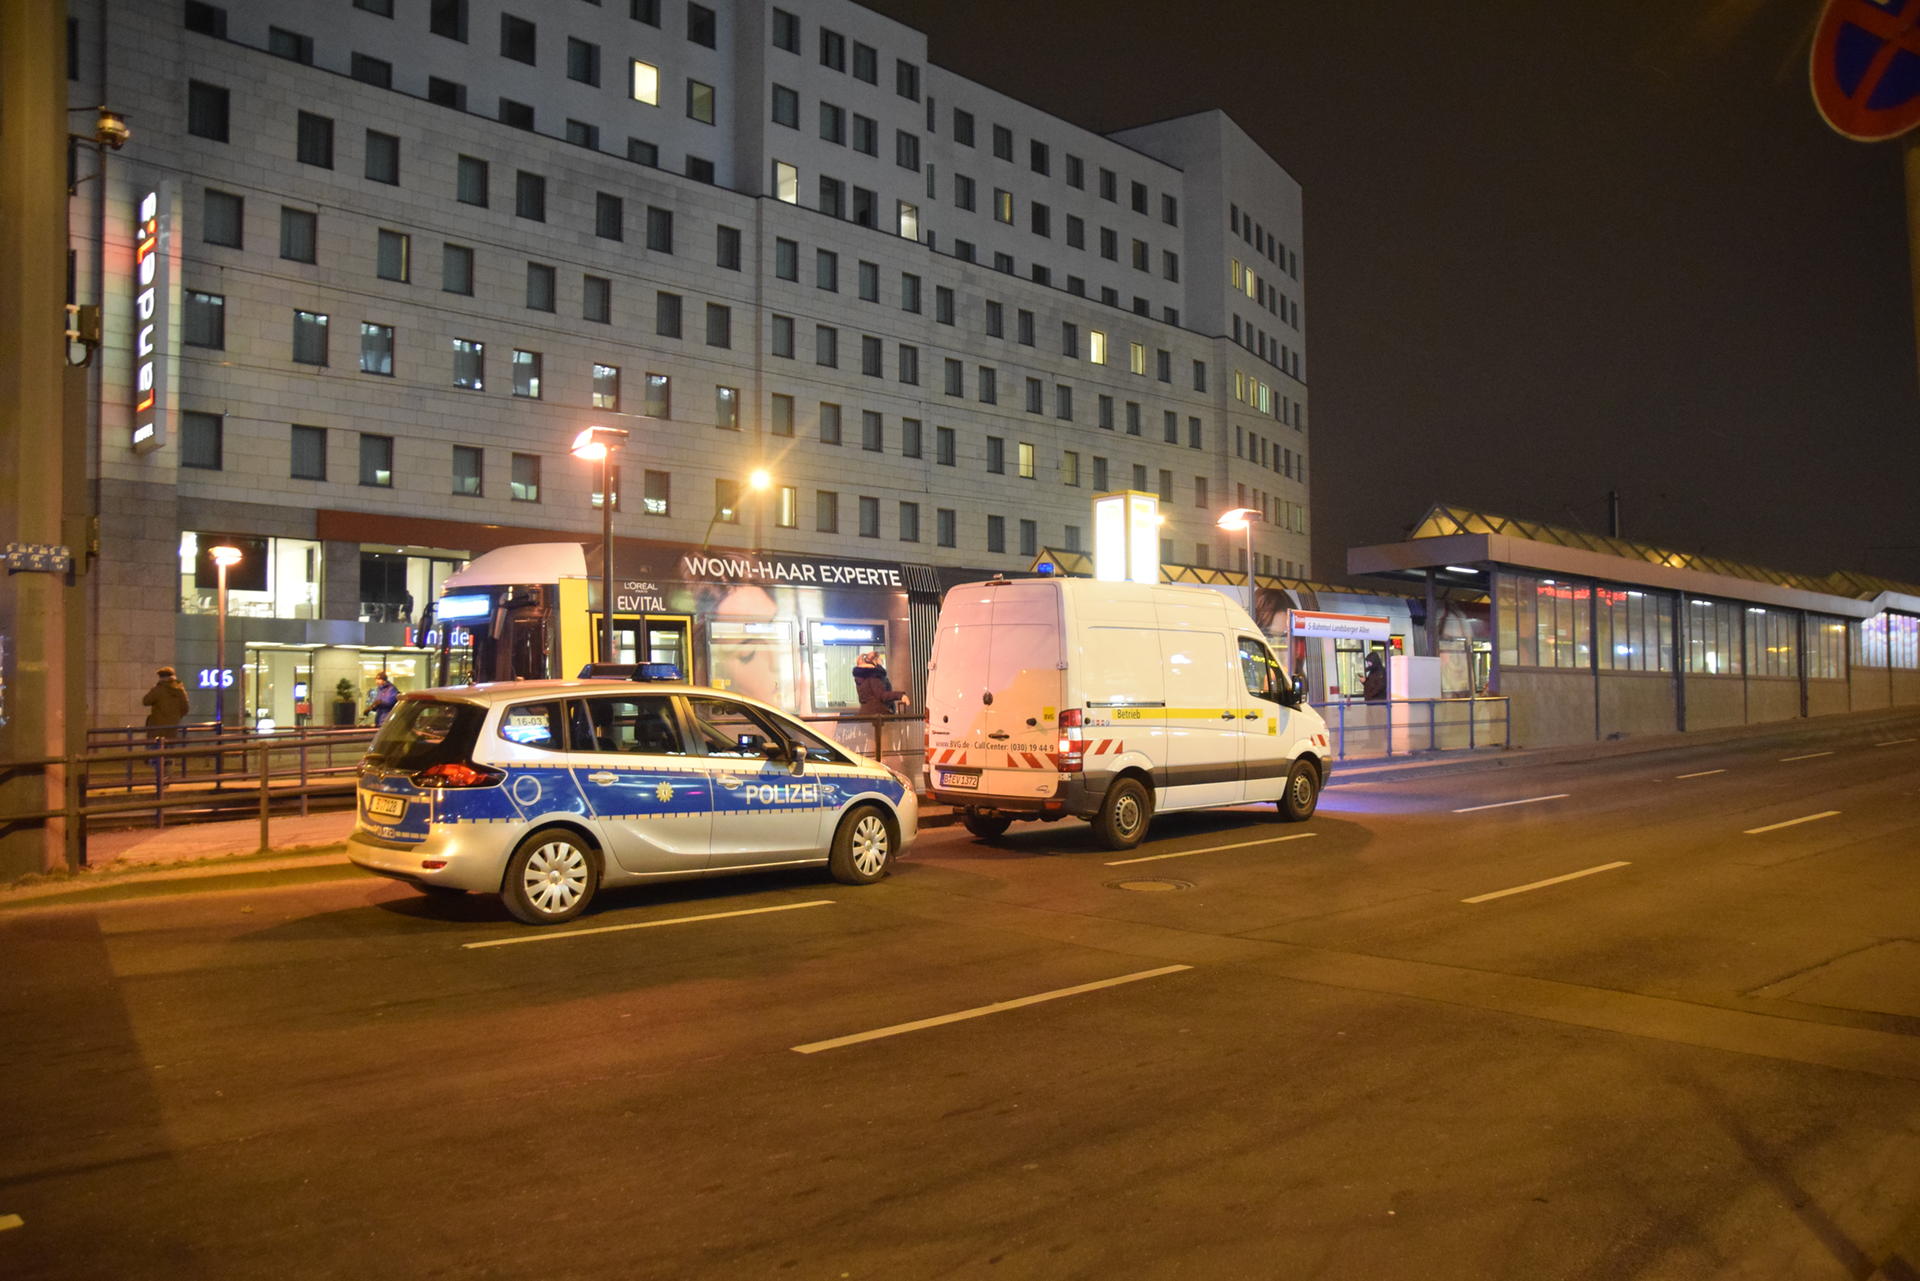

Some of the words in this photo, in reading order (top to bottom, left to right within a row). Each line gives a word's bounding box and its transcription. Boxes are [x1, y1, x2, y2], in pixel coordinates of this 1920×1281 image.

[684, 556, 816, 582] WOW!-HAAR
[819, 565, 902, 587] EXPERTE
[617, 595, 667, 612] ELVITAL
[1044, 713, 1055, 721] BVG
[1117, 709, 1141, 720] Betrieb
[1010, 743, 1027, 752] (030)
[1029, 744, 1038, 752] 19
[1039, 744, 1048, 752] 44
[746, 783, 818, 805] POLIZEI
